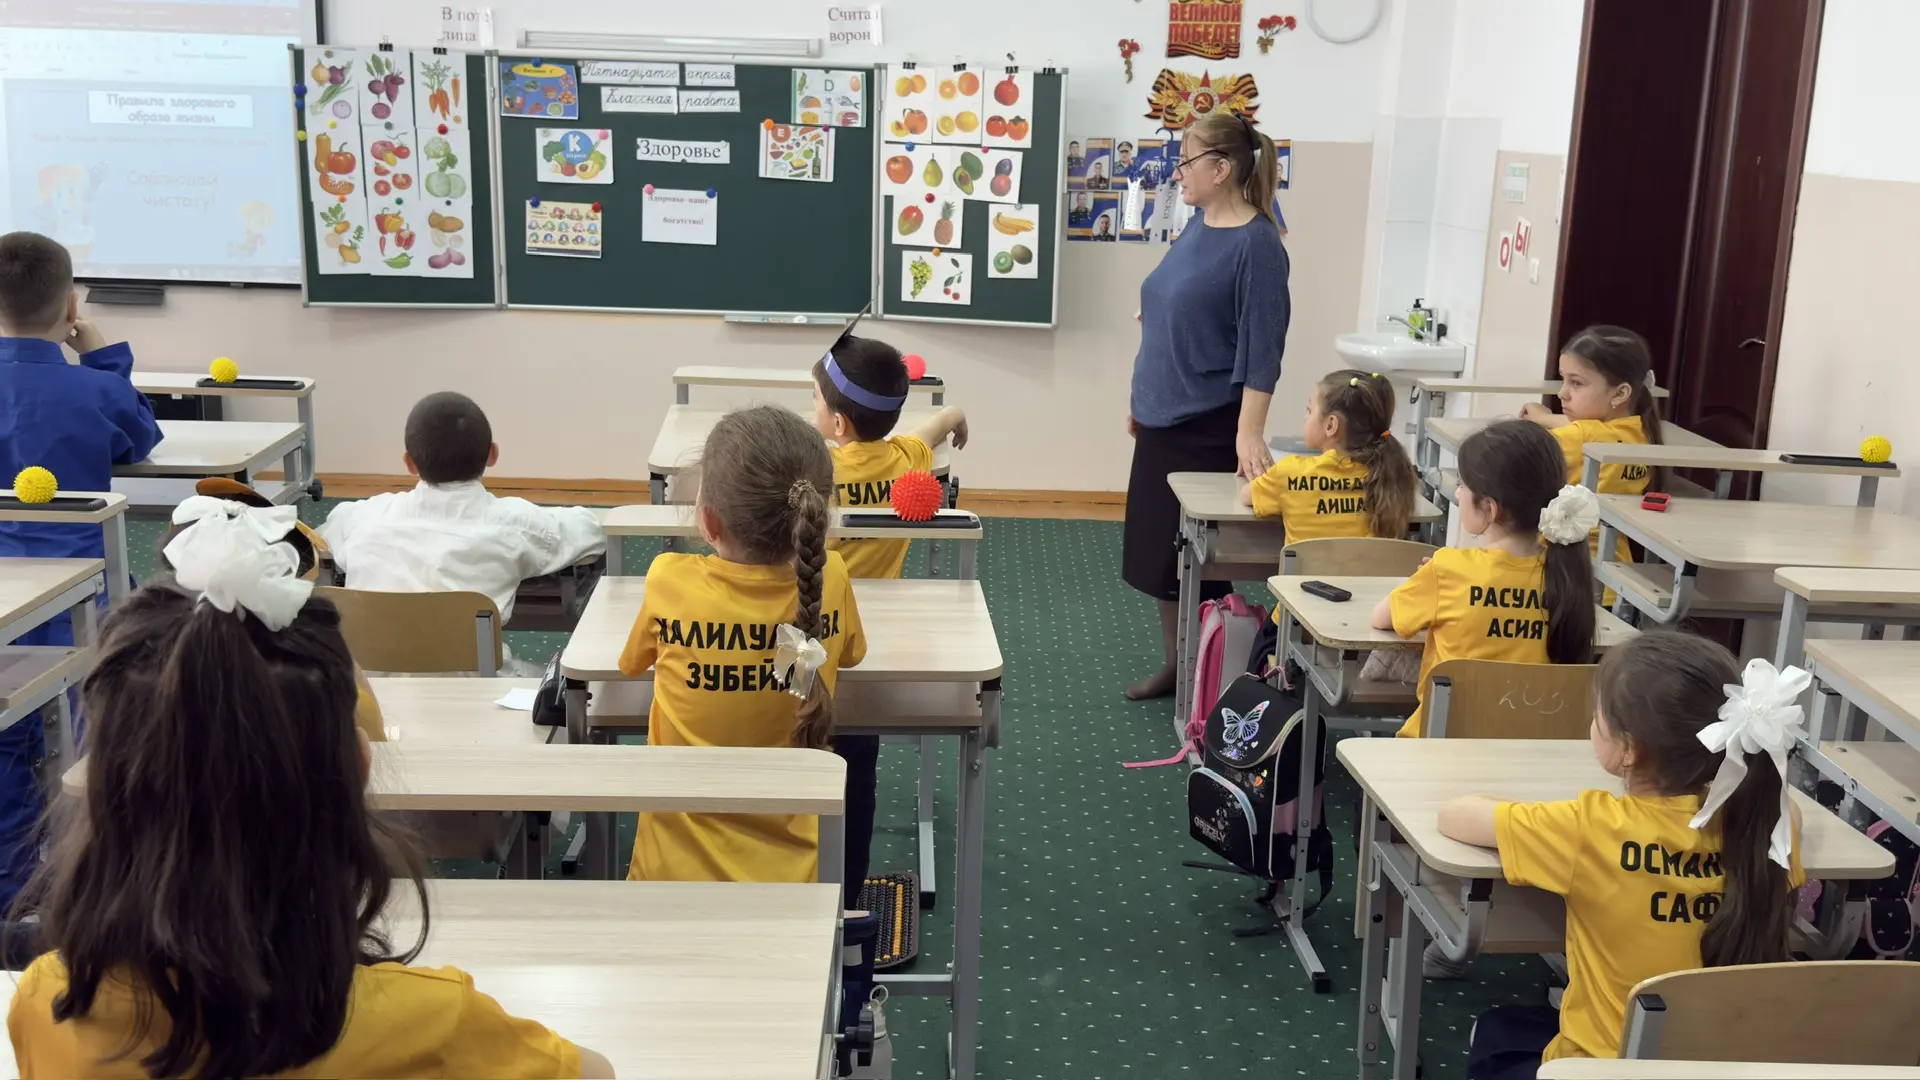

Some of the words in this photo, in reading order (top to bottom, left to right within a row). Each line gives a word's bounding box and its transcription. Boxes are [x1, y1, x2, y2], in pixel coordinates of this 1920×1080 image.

[441, 6, 453, 20] В
[827, 7, 879, 22] Счита
[1169, 3, 1241, 22] ВЕЛИКОЙ
[442, 31, 477, 43] лица
[829, 31, 871, 44] ворон
[824, 79, 835, 92] D
[106, 93, 165, 109] Правила
[170, 97, 236, 111] здорового
[128, 110, 171, 125] образа
[174, 114, 216, 124] жизни
[640, 139, 721, 160] Здоровье
[1287, 475, 1366, 491] МАГОМЕД
[1487, 618, 1551, 640] АСИЯ
[1620, 840, 1724, 878] ОСМАН
[1651, 891, 1724, 923] САФ
